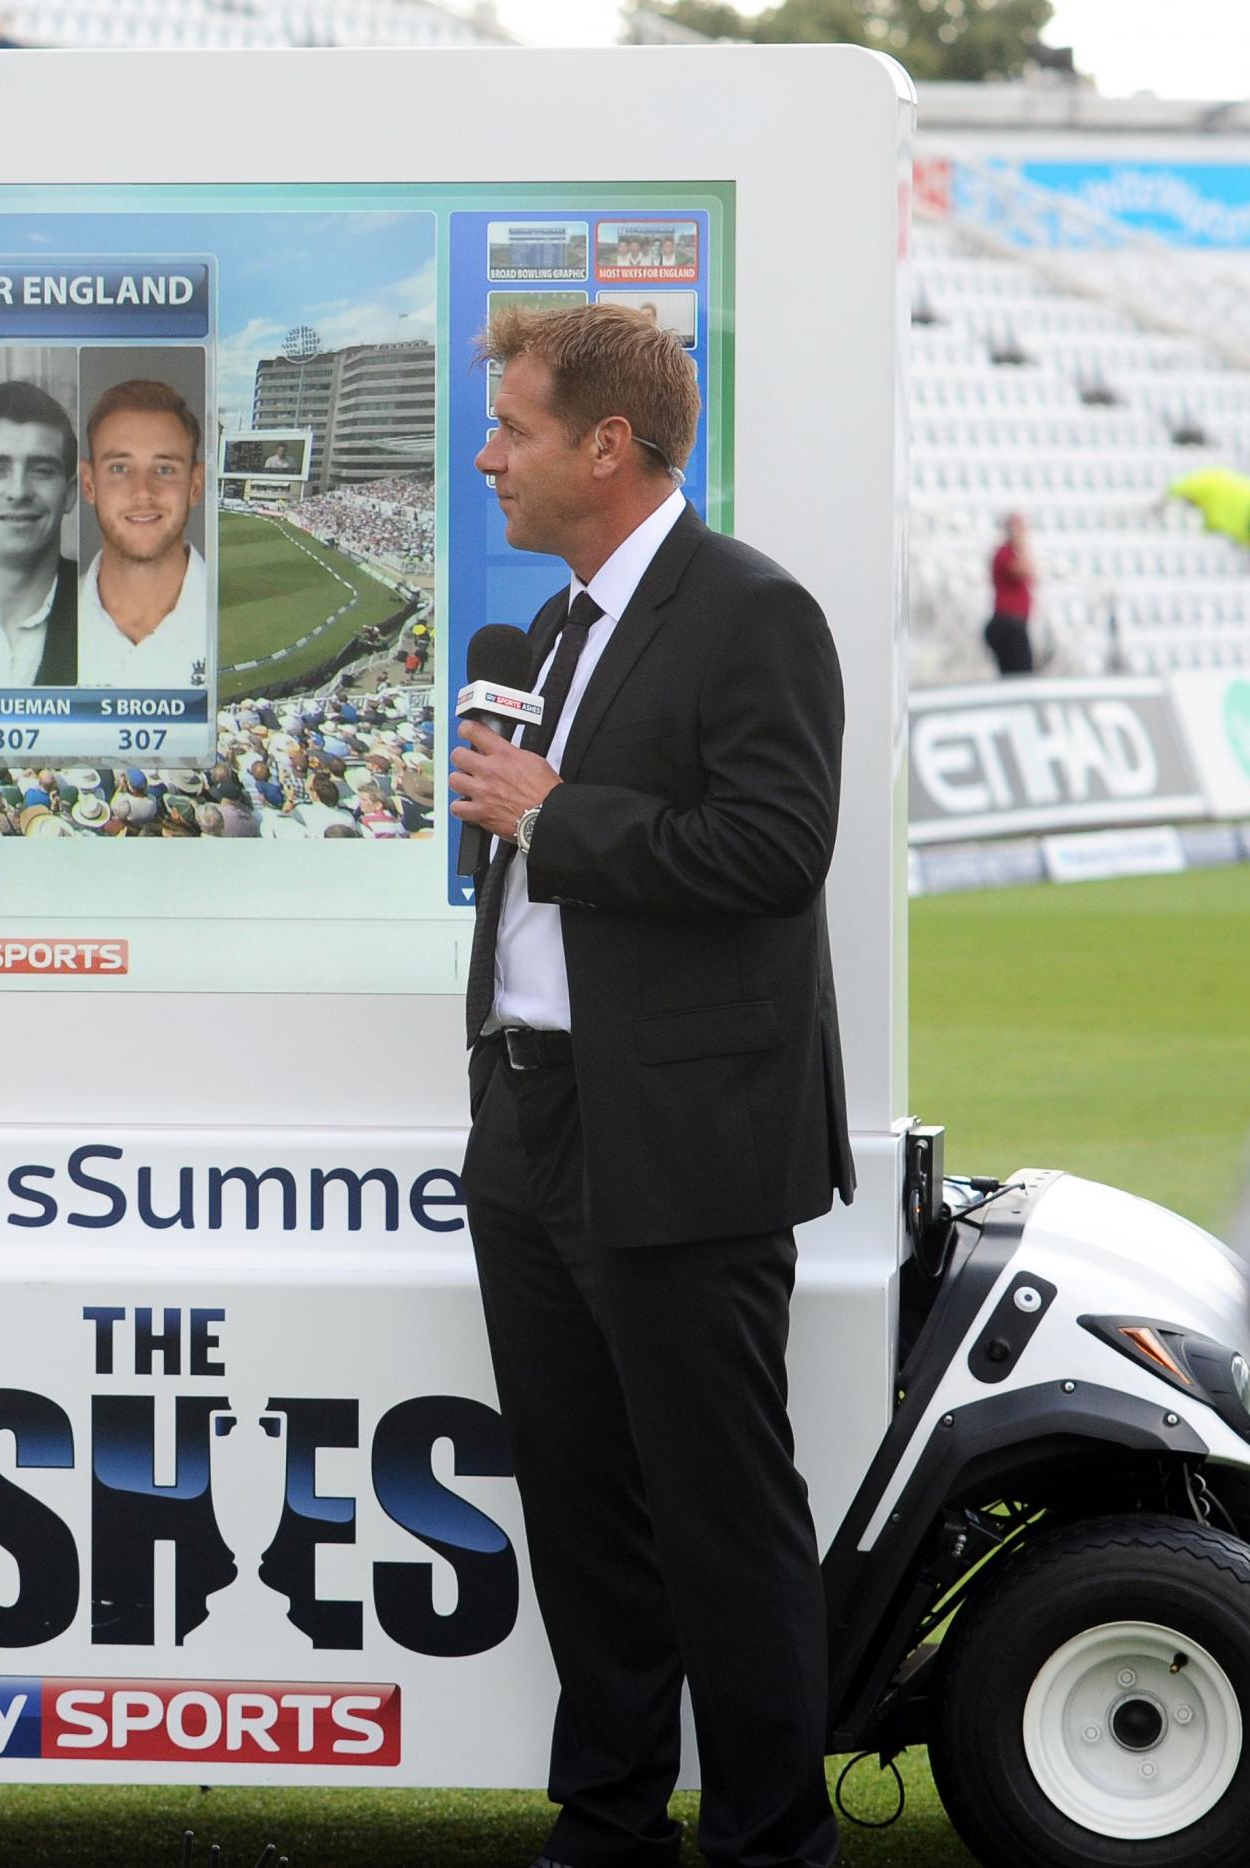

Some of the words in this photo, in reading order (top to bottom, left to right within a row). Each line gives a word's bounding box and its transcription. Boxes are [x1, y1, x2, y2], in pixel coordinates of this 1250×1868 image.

[490, 269, 517, 279] BROAD
[517, 269, 552, 279] BOWLING
[552, 269, 586, 279] GRAPHIC
[599, 268, 620, 278] MOST
[642, 268, 658, 278] FOR
[658, 268, 695, 278] ENGLAND
[23, 275, 194, 305] ENGLAND
[102, 699, 112, 716] S
[117, 699, 185, 716] BROAD
[496, 696, 522, 709] SPORTS
[522, 703, 540, 714] ASHES
[118, 729, 168, 751] 307
[914, 700, 1158, 815] ETIHAD
[82, 1306, 226, 1376] THE
[56, 1689, 385, 1755] SPORTS
